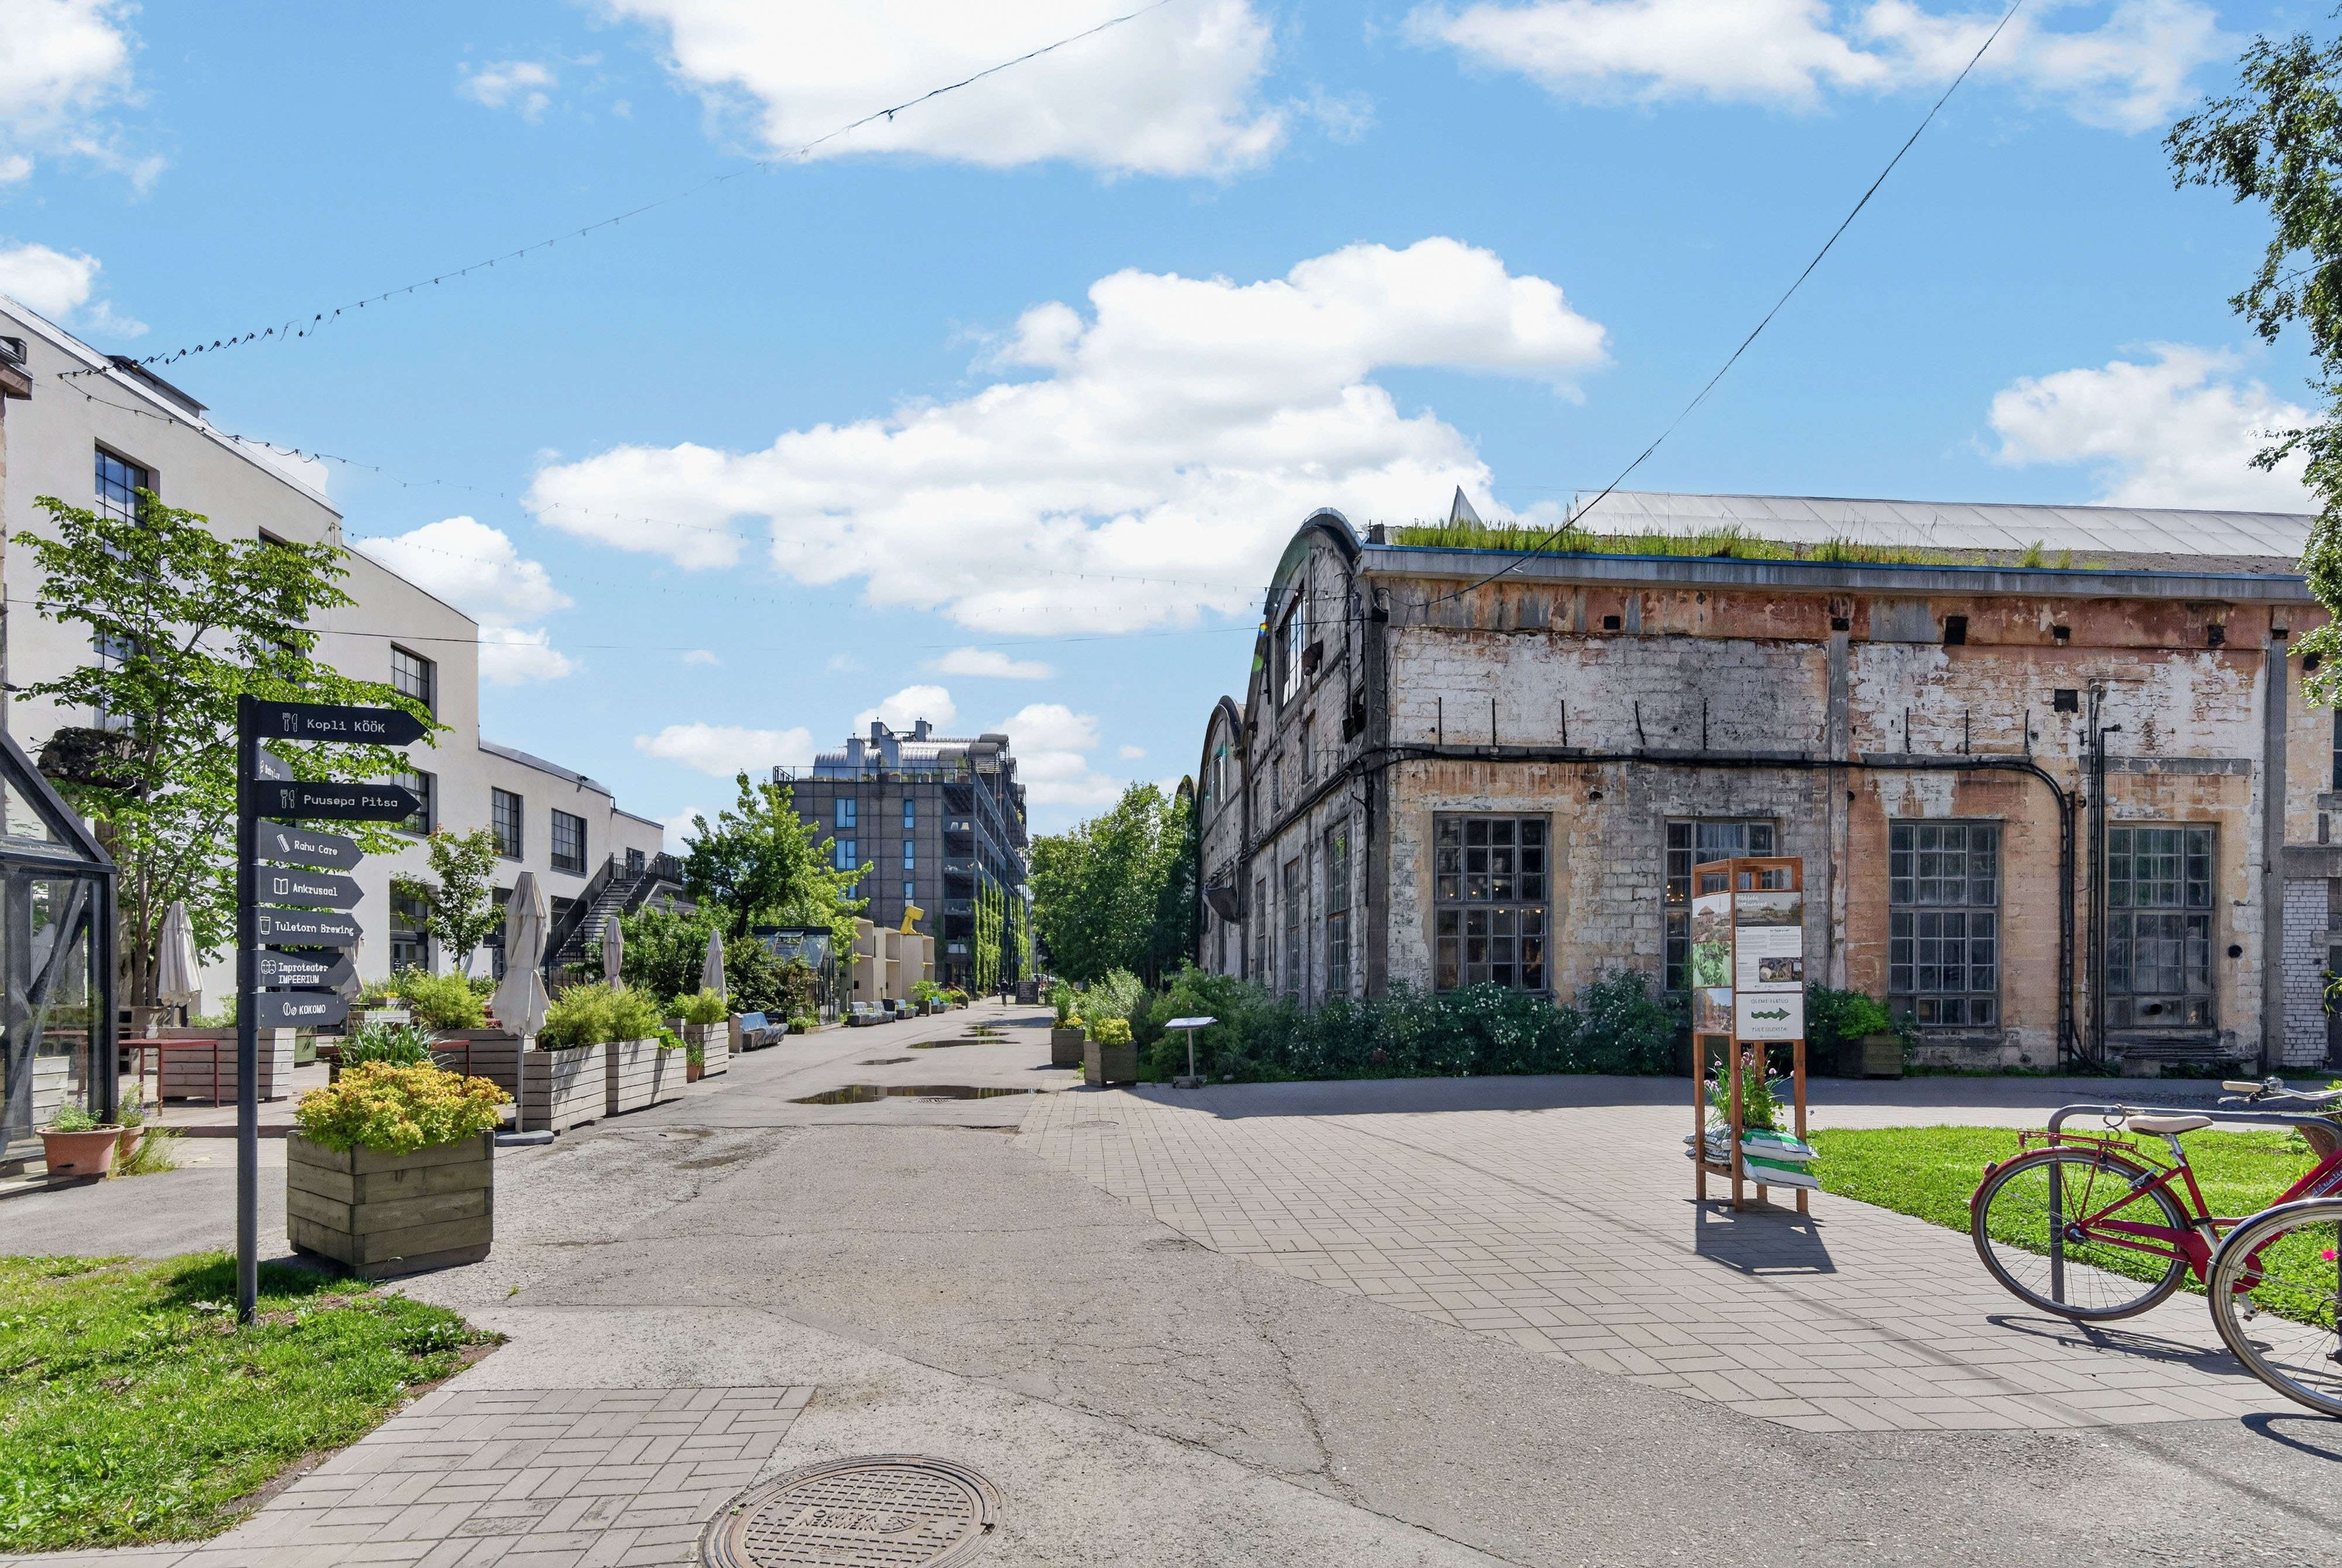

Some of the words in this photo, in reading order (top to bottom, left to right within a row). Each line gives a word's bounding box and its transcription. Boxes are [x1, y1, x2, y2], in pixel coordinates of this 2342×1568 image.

[307, 718, 347, 731] Kopli
[354, 720, 385, 733] KÖÖK
[304, 795, 355, 807] Puusepa
[362, 796, 398, 807] Pitsa
[319, 844, 338, 855] Care
[293, 883, 338, 896] Ankrusaal
[275, 921, 316, 933] Tuletorn
[321, 924, 354, 936] Brewing
[278, 963, 328, 973] Improteater
[278, 975, 319, 984] IMPEERIUM
[299, 1004, 326, 1015] KOKOMO
